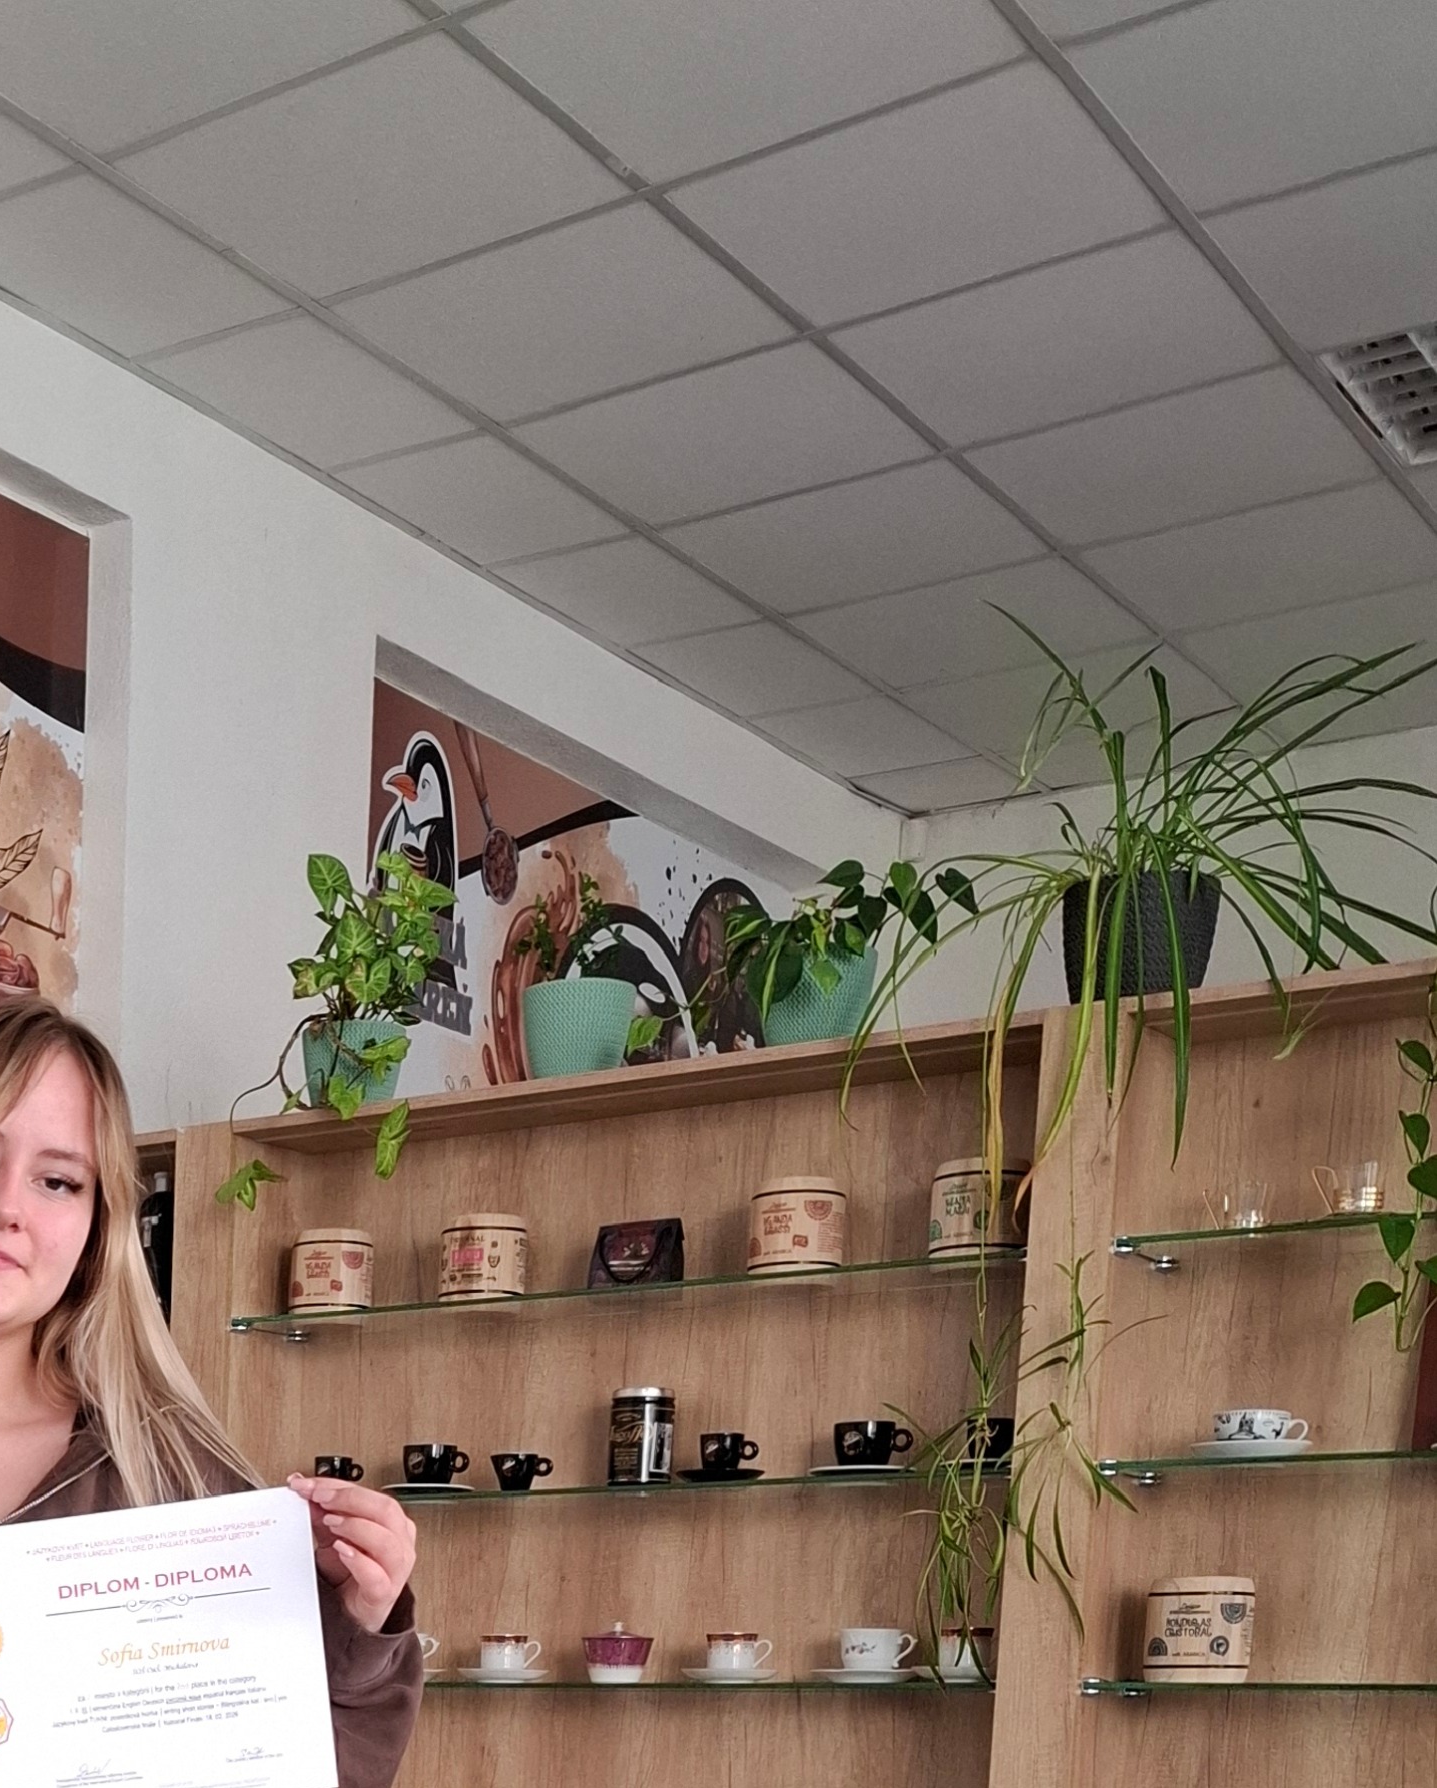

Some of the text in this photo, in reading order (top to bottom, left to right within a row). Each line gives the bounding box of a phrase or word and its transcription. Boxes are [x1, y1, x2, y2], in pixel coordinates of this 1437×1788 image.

[58, 1576, 139, 1599] DIPLOM
[154, 1563, 252, 1587] DIPLOMA
[1165, 1617, 1212, 1628] HONDURAS
[98, 1636, 231, 1668] Sofia Smirnova
